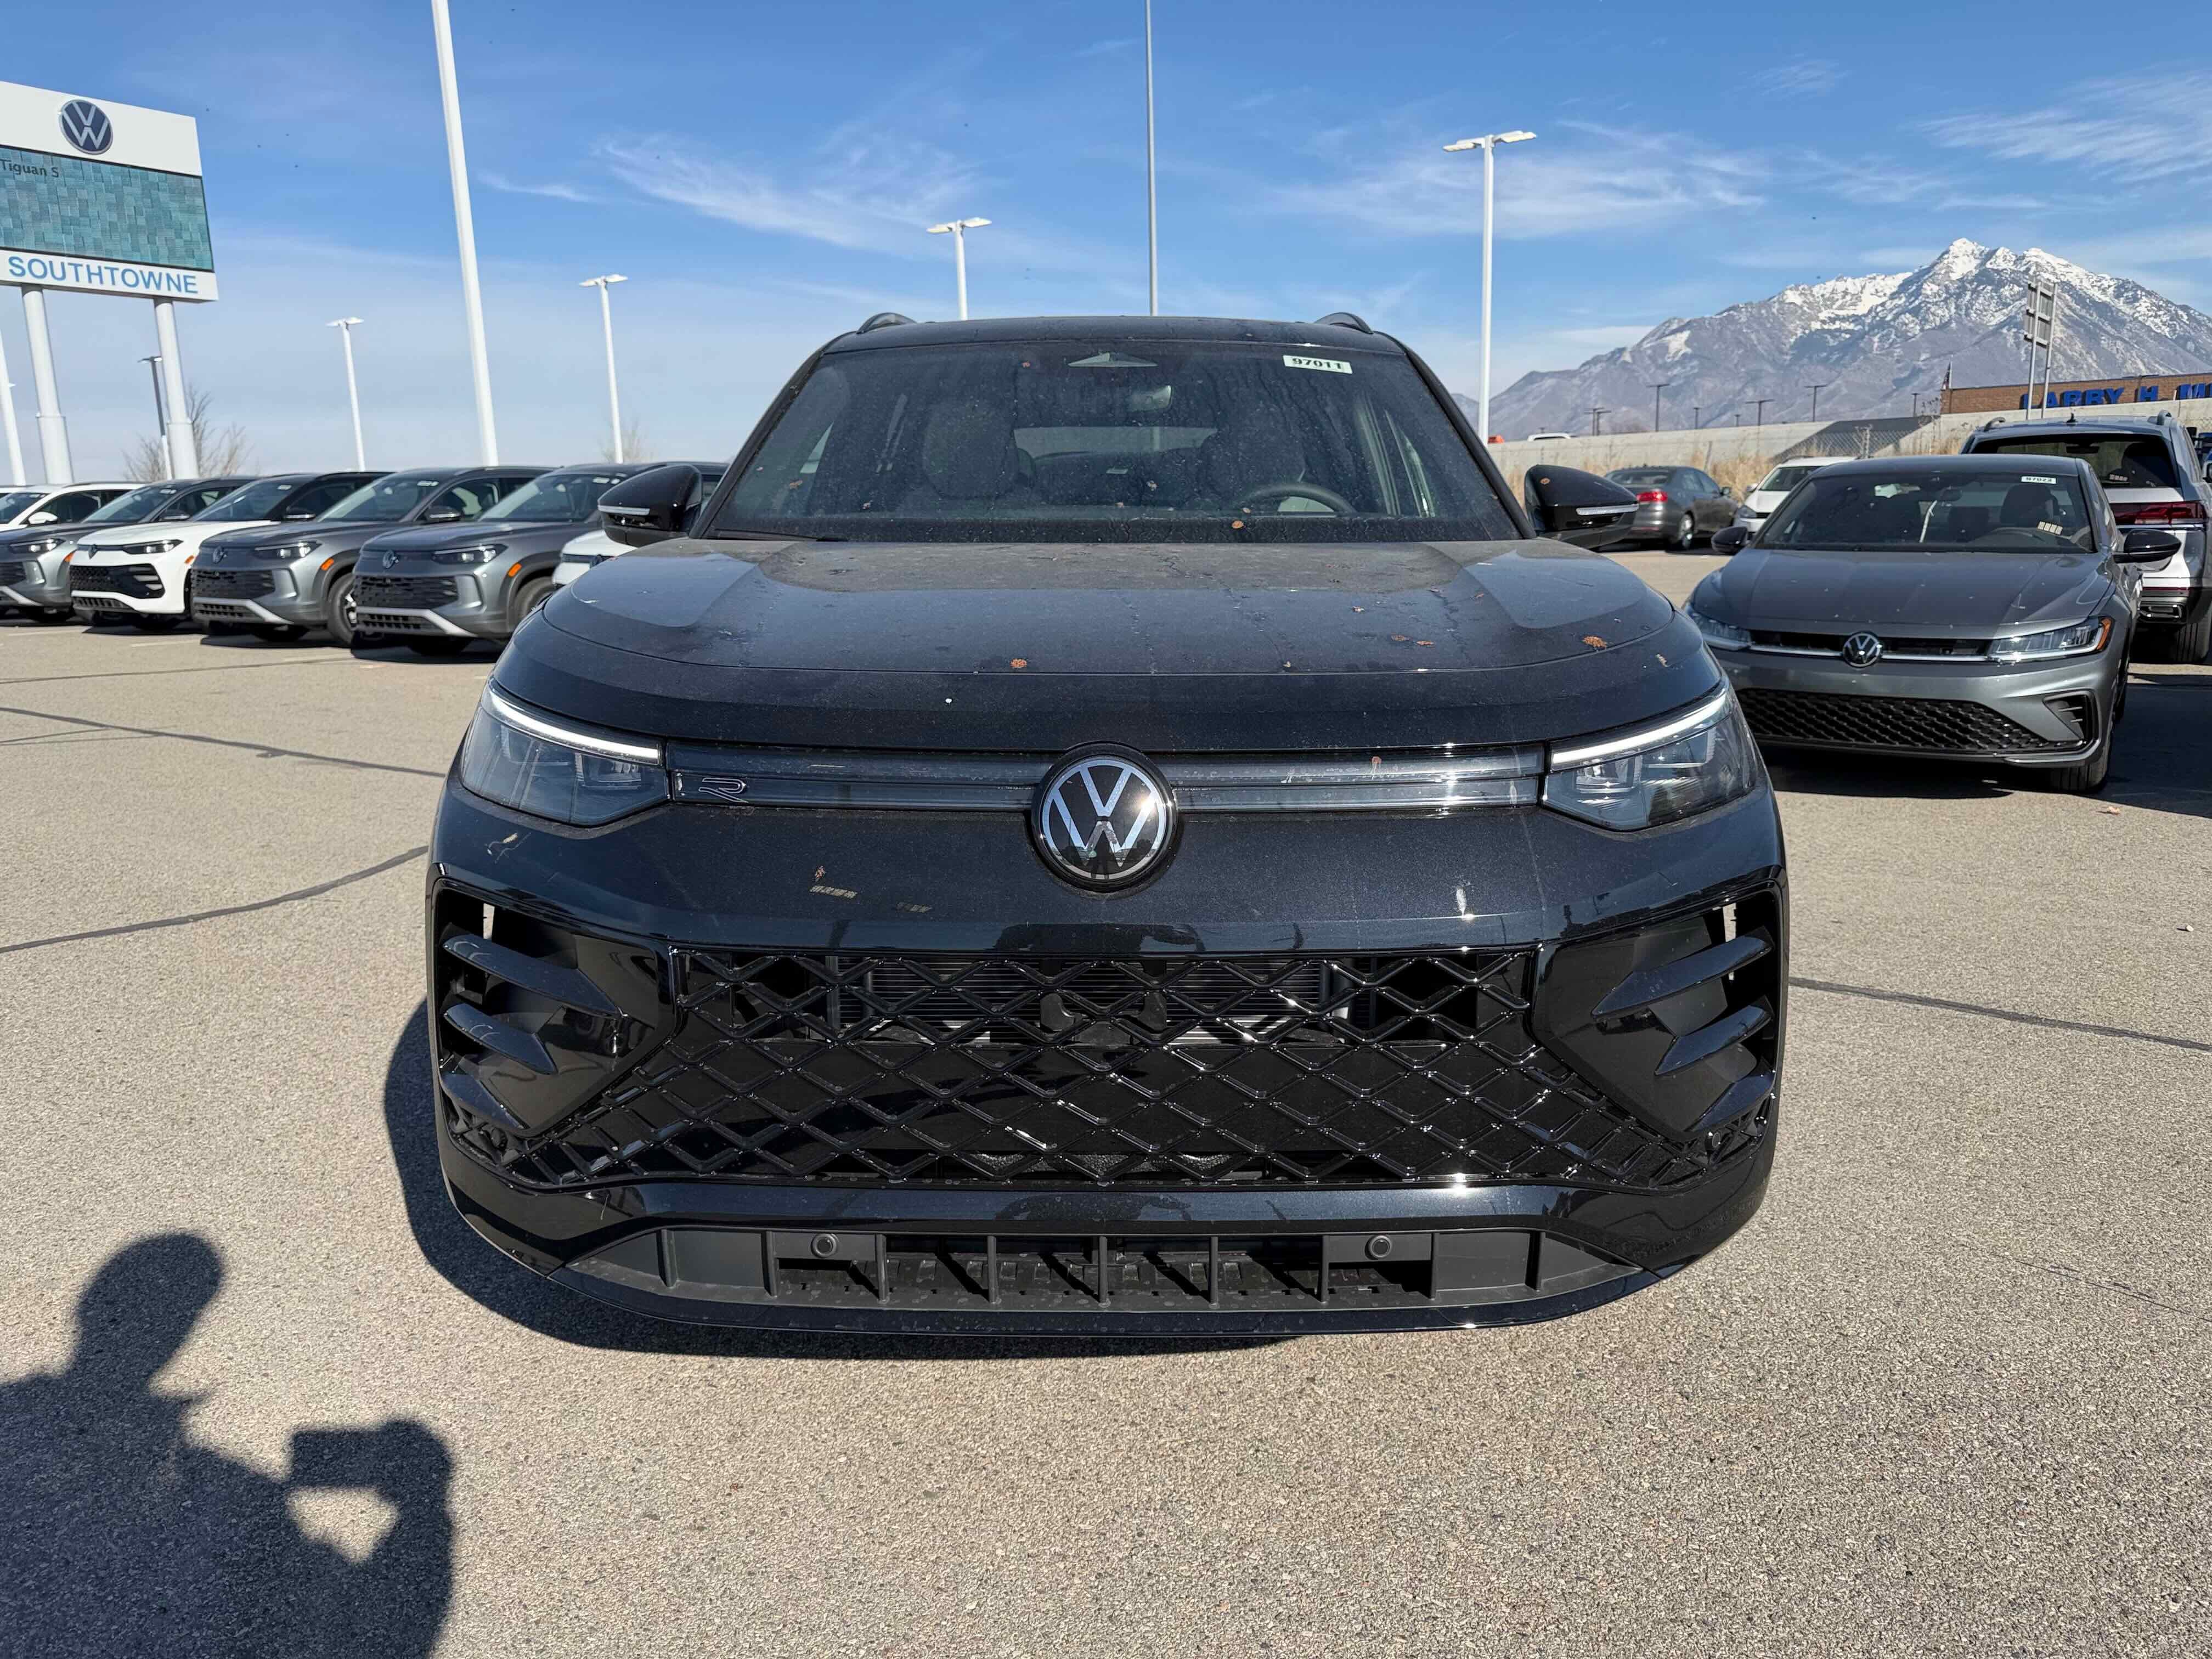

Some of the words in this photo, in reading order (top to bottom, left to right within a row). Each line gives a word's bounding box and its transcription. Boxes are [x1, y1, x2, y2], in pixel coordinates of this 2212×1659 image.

[60, 100, 112, 154] VW
[0, 159, 47, 176] Tiguan
[8, 256, 199, 294] SOUTHTOWNE
[1292, 358, 1342, 369] 97011
[1042, 759, 1166, 879] VW
